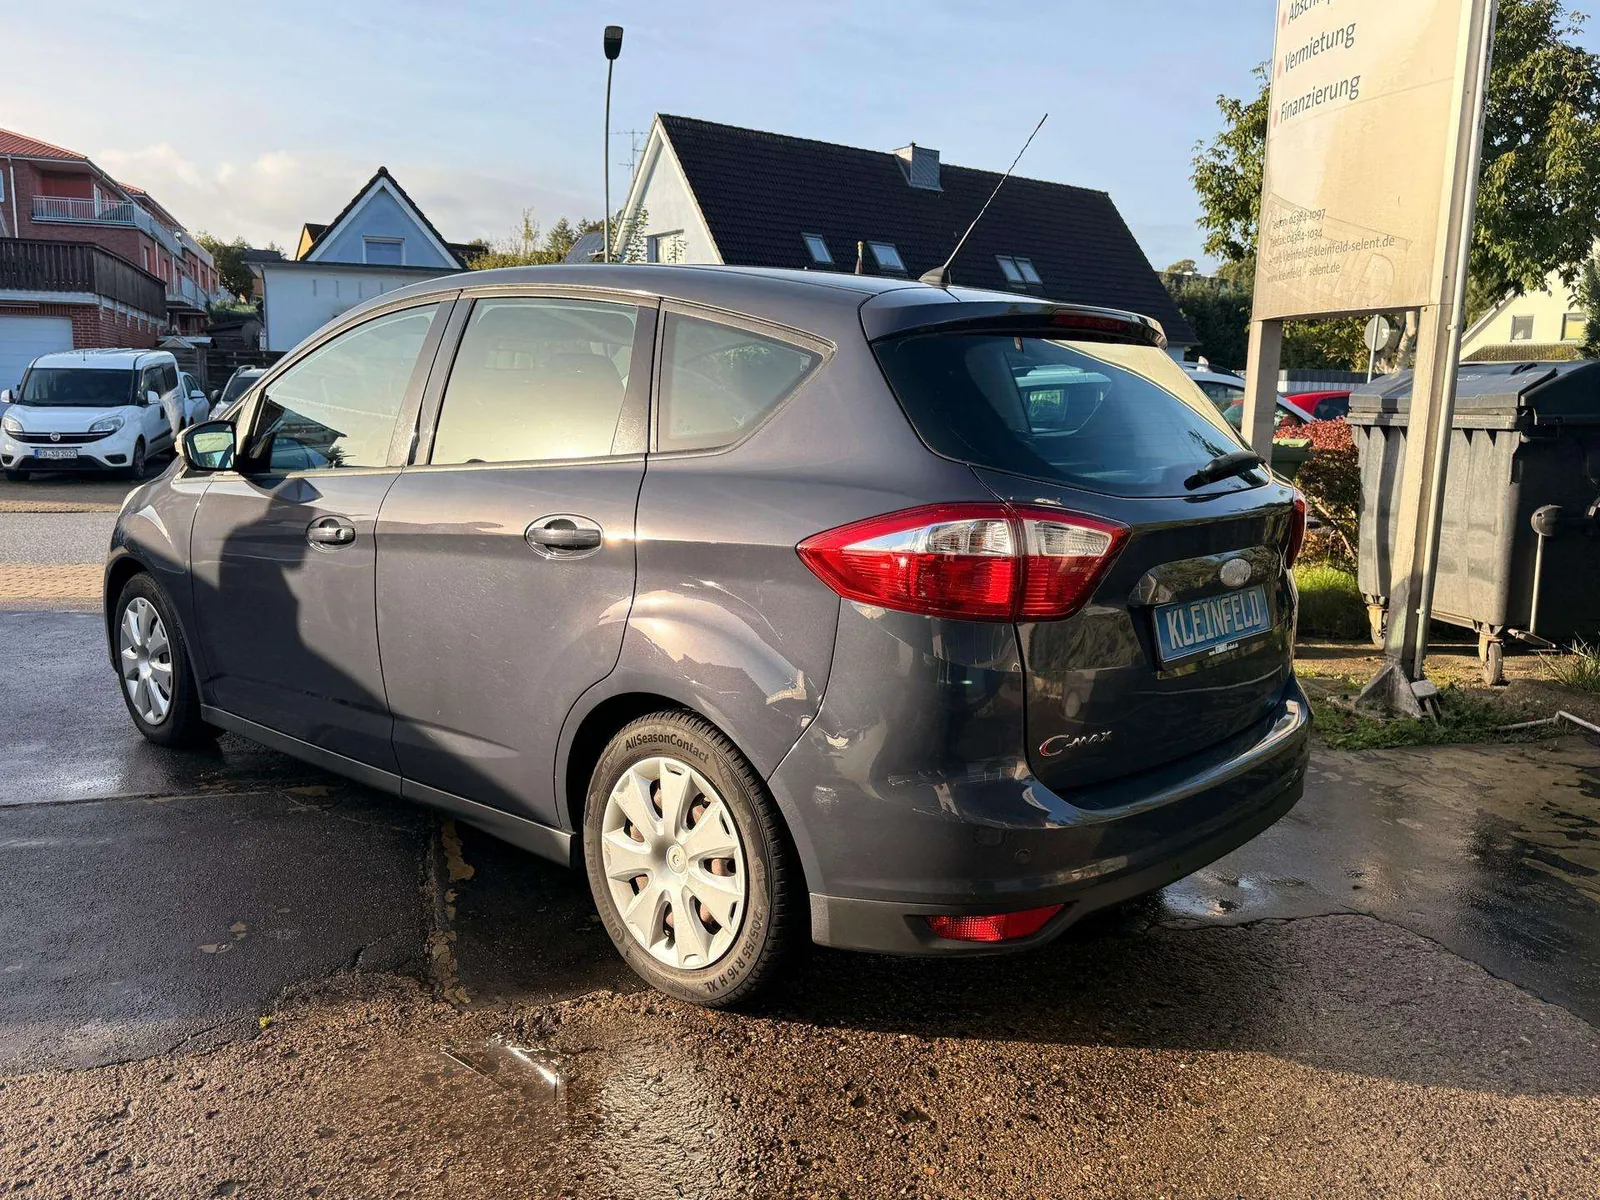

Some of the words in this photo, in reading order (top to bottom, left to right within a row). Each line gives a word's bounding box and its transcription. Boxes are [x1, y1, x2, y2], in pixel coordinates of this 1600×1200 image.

[1284, 22, 1356, 73] Vermietung
[1280, 75, 1361, 123] Finanzierung
[1166, 590, 1261, 650] KLEINFELD
[625, 733, 709, 764] AllSeasonContact
[742, 907, 763, 960] 205/55
[727, 965, 739, 980] 16
[735, 956, 746, 969] R
[704, 980, 719, 993] XL
[719, 974, 728, 987] H
